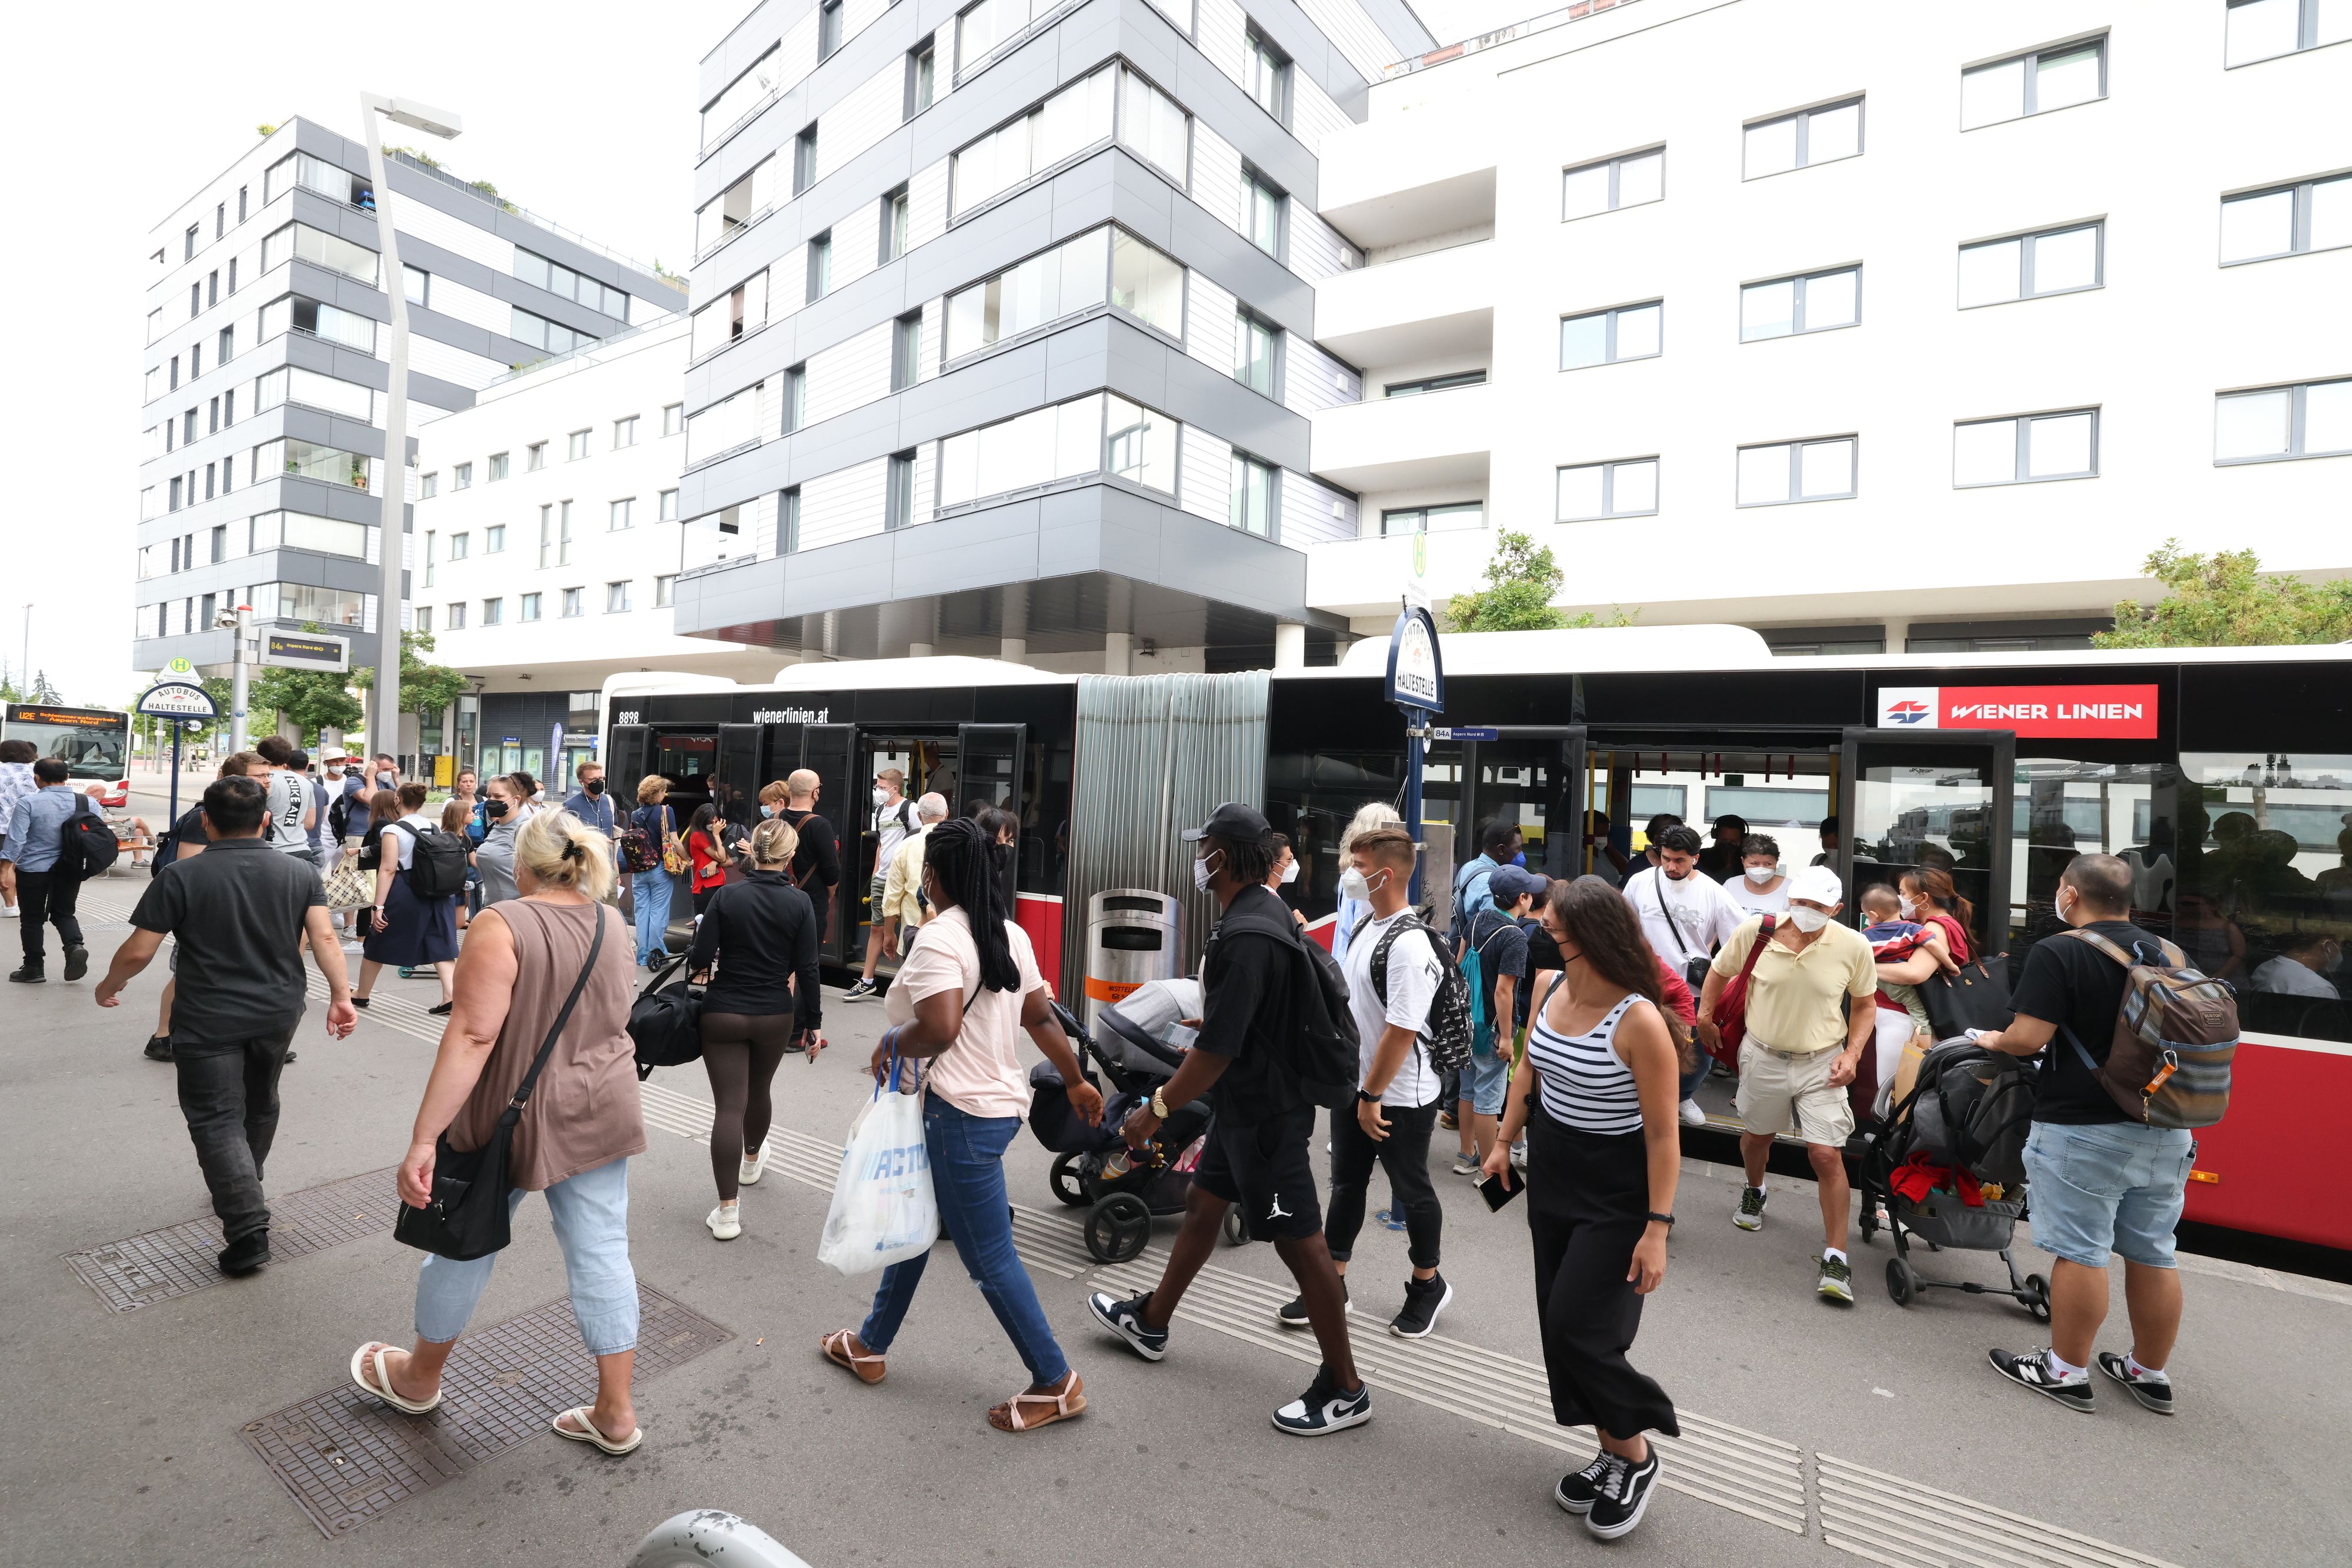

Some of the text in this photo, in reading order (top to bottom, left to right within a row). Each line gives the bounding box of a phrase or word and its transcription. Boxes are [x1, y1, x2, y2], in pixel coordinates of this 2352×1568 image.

[1405, 623, 1431, 660] AUTOBUS
[175, 660, 185, 670] H
[1398, 669, 1434, 697] HALTESTELLE
[158, 687, 201, 700] AUTOBUS
[148, 703, 207, 713] HALTESTELLE
[1952, 704, 2142, 720] WIENER LINIEN
[19, 712, 118, 723] U2E Schienenersatzverkehr
[619, 711, 639, 724] 8898
[753, 707, 828, 724] wienerlinien.at
[285, 778, 301, 824] NIKE AIR
